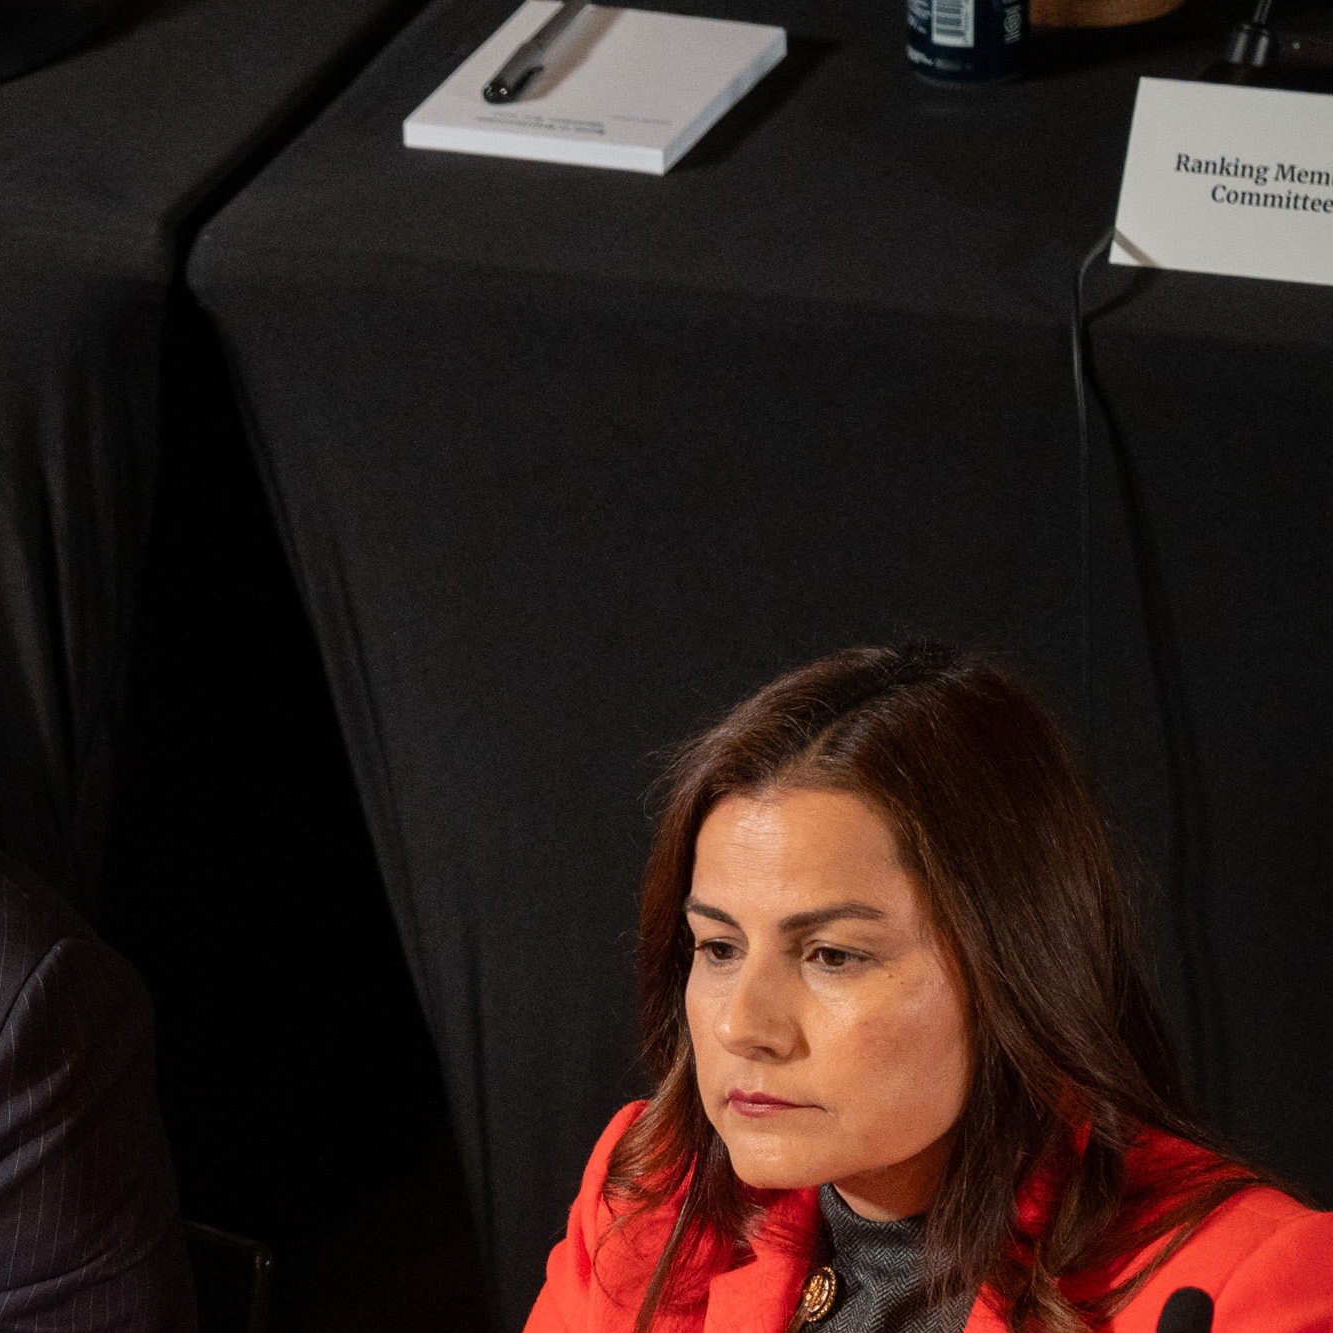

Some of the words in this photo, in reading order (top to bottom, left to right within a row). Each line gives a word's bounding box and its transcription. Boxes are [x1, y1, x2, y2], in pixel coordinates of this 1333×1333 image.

[1174, 153, 1269, 186] Ranking
[1274, 163, 1333, 187] Mem
[1211, 183, 1333, 213] Committee
